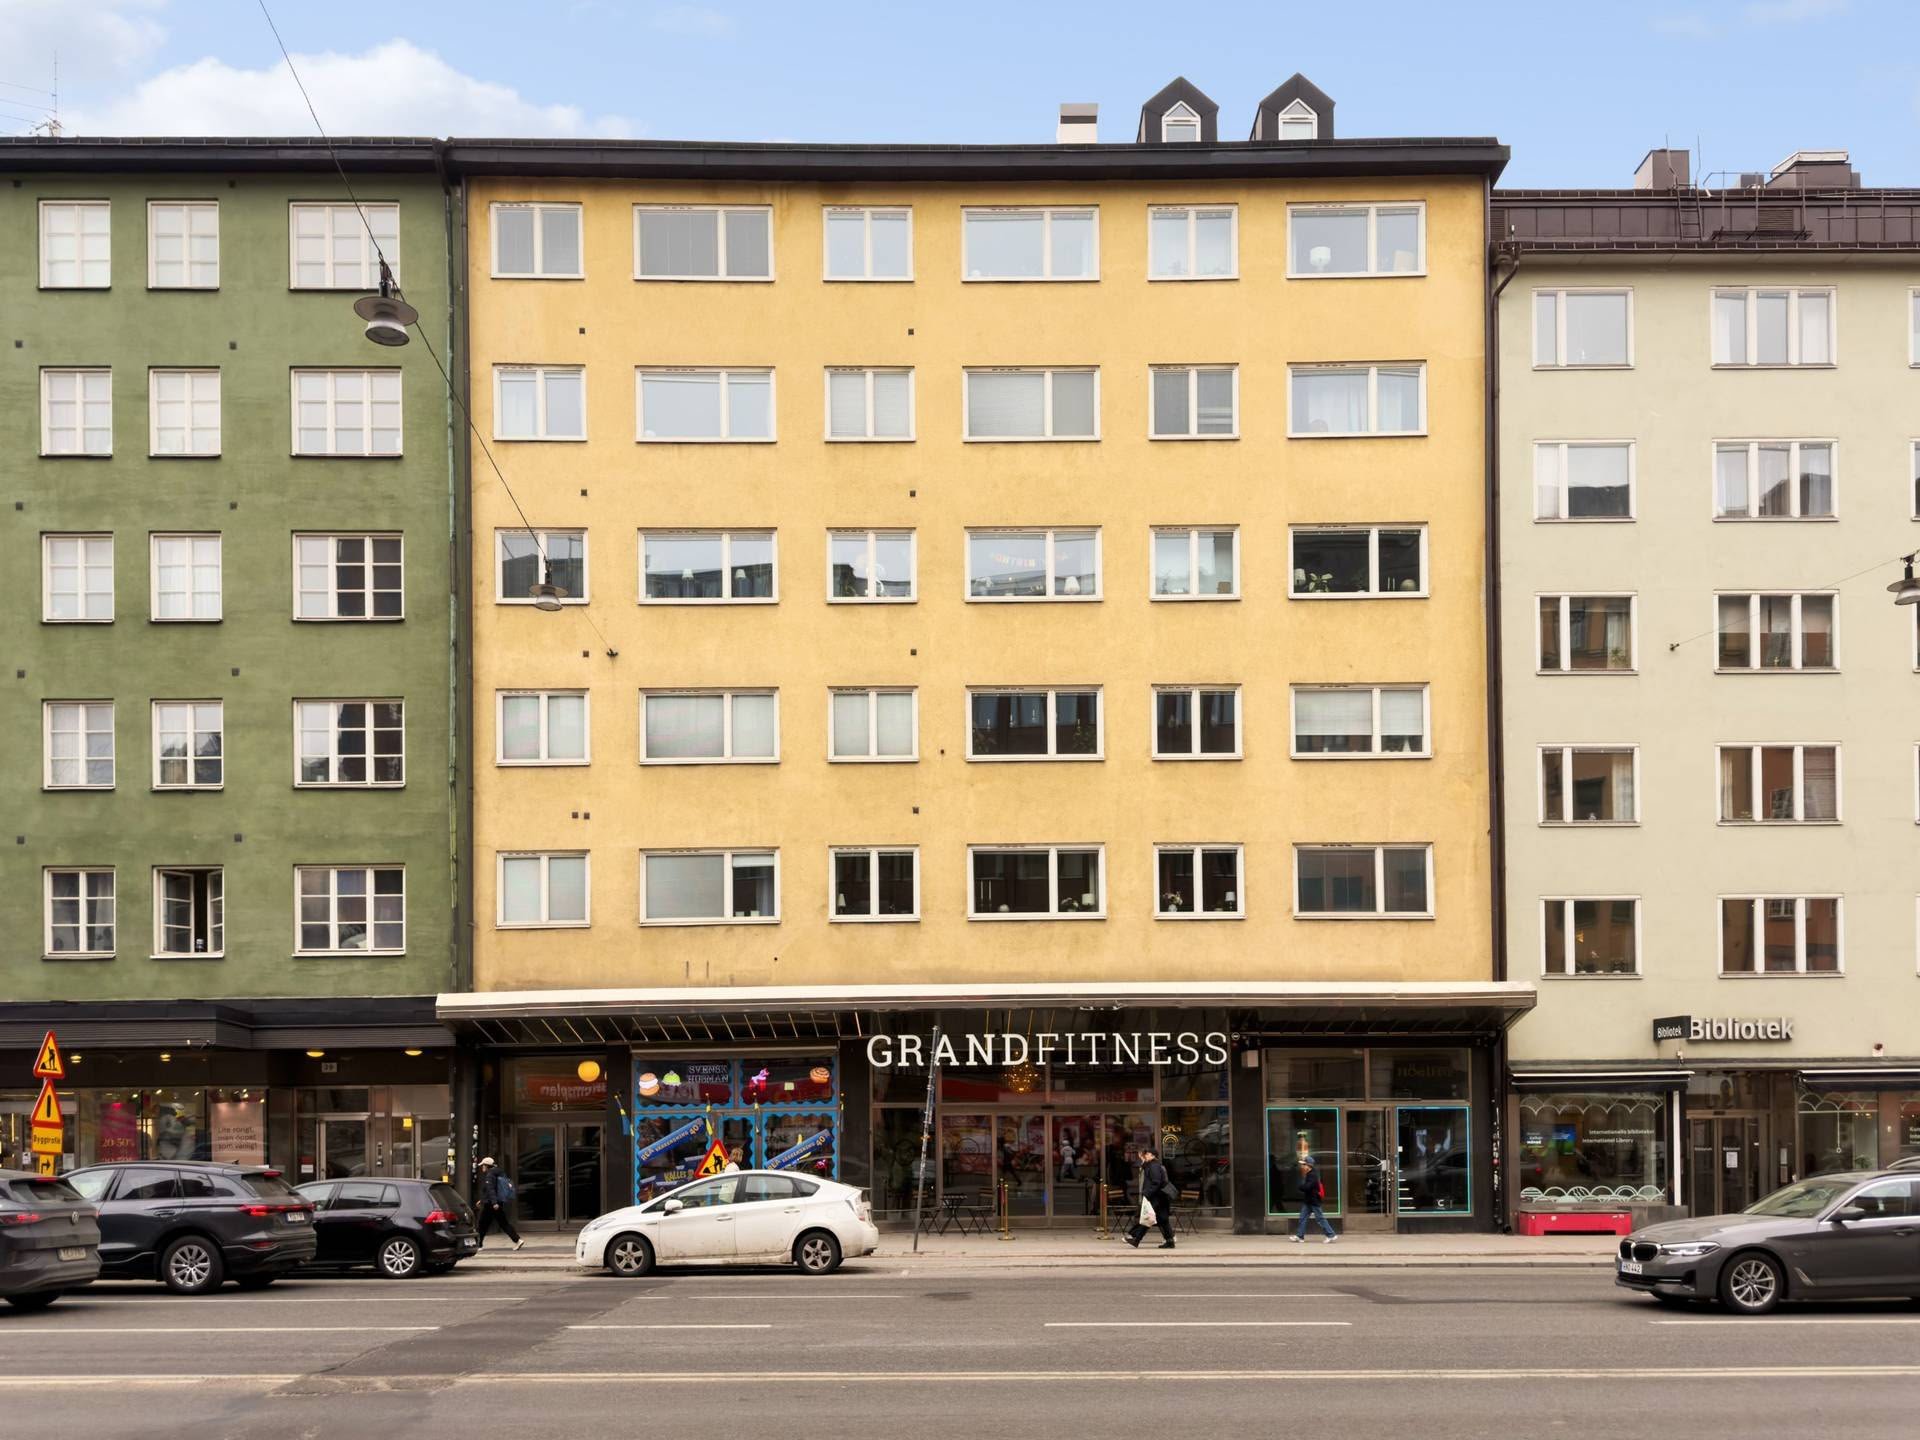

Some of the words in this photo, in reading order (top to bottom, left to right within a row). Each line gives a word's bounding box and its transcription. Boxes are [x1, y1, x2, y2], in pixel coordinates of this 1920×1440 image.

[1656, 1025, 1682, 1039] Bibliotek
[1690, 1017, 1793, 1040] Bibliotek
[551, 1102, 564, 1111] 31
